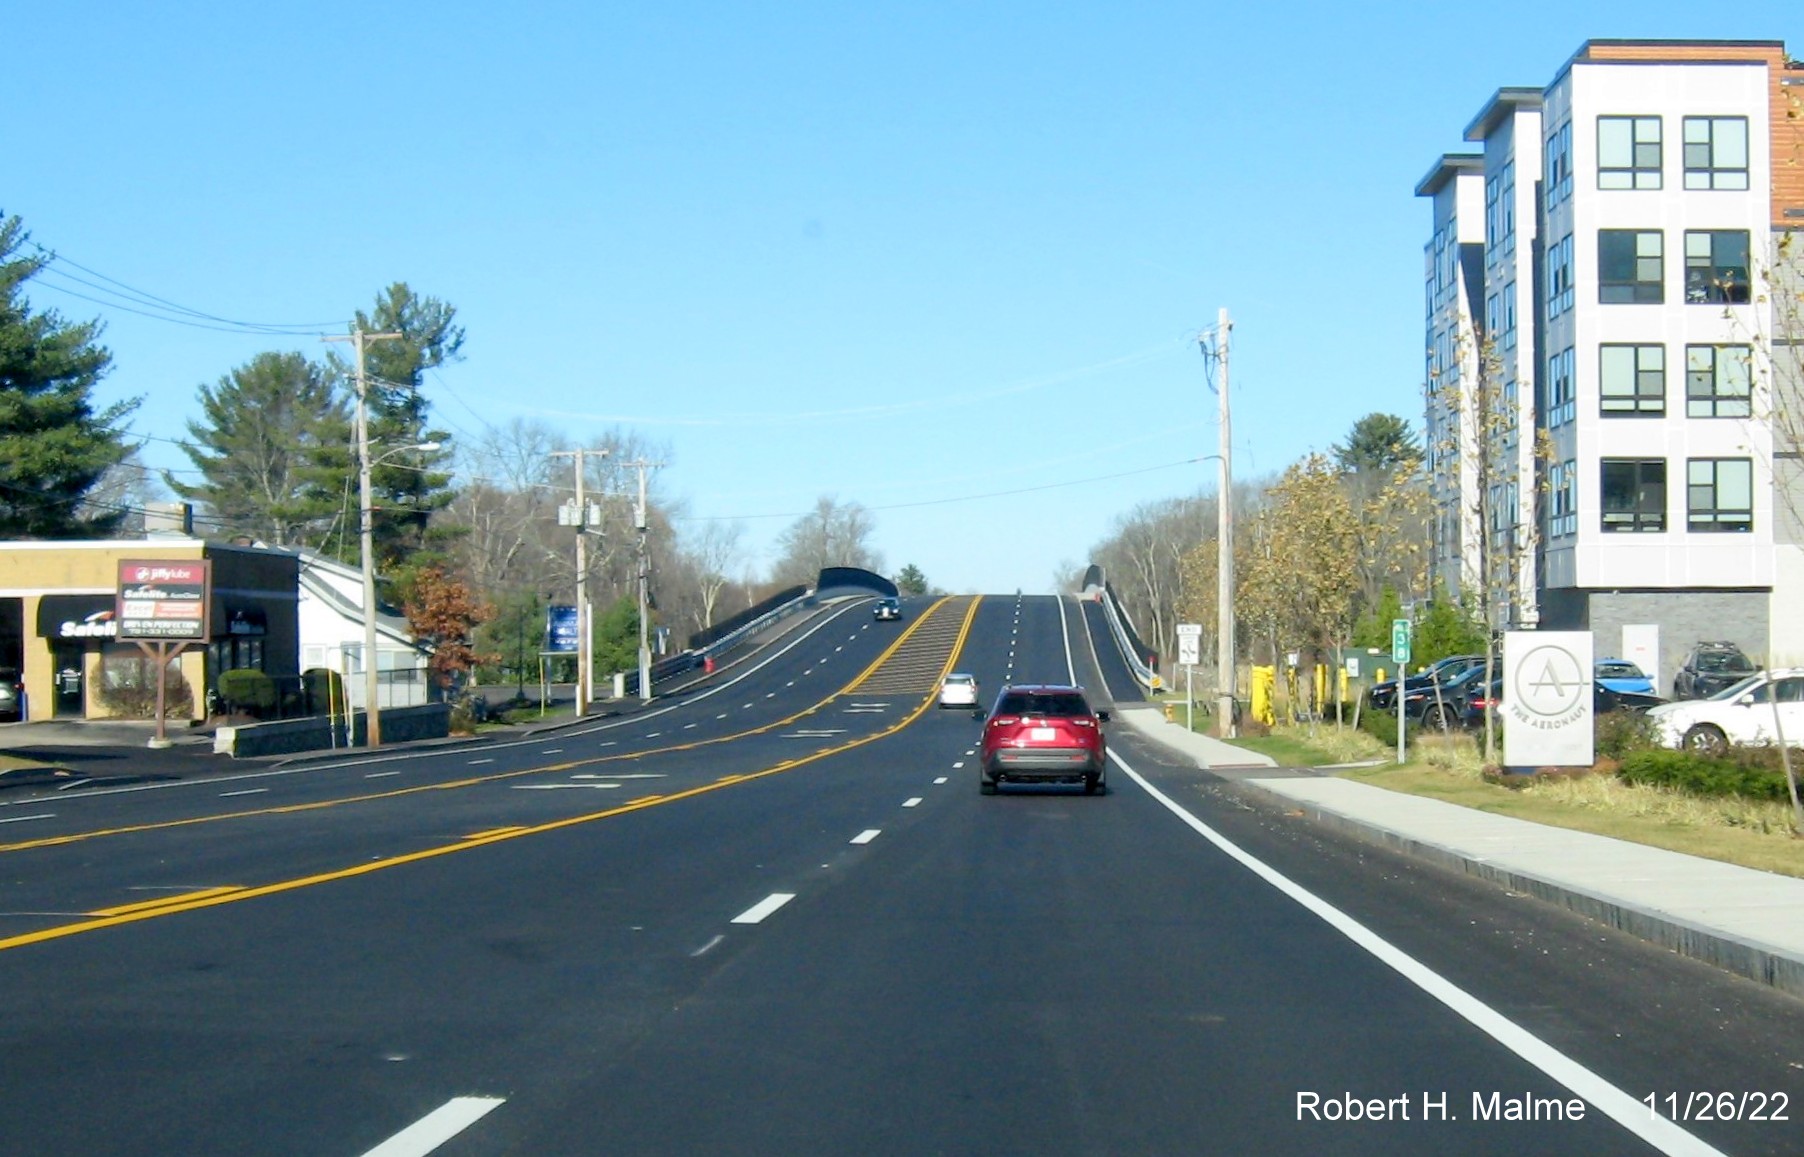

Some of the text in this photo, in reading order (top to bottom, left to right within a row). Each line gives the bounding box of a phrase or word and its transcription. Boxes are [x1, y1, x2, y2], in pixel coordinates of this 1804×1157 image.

[124, 589, 167, 599] Safelite
[60, 621, 117, 637] Safeli
[1511, 703, 1587, 729] THE AERONAUT
